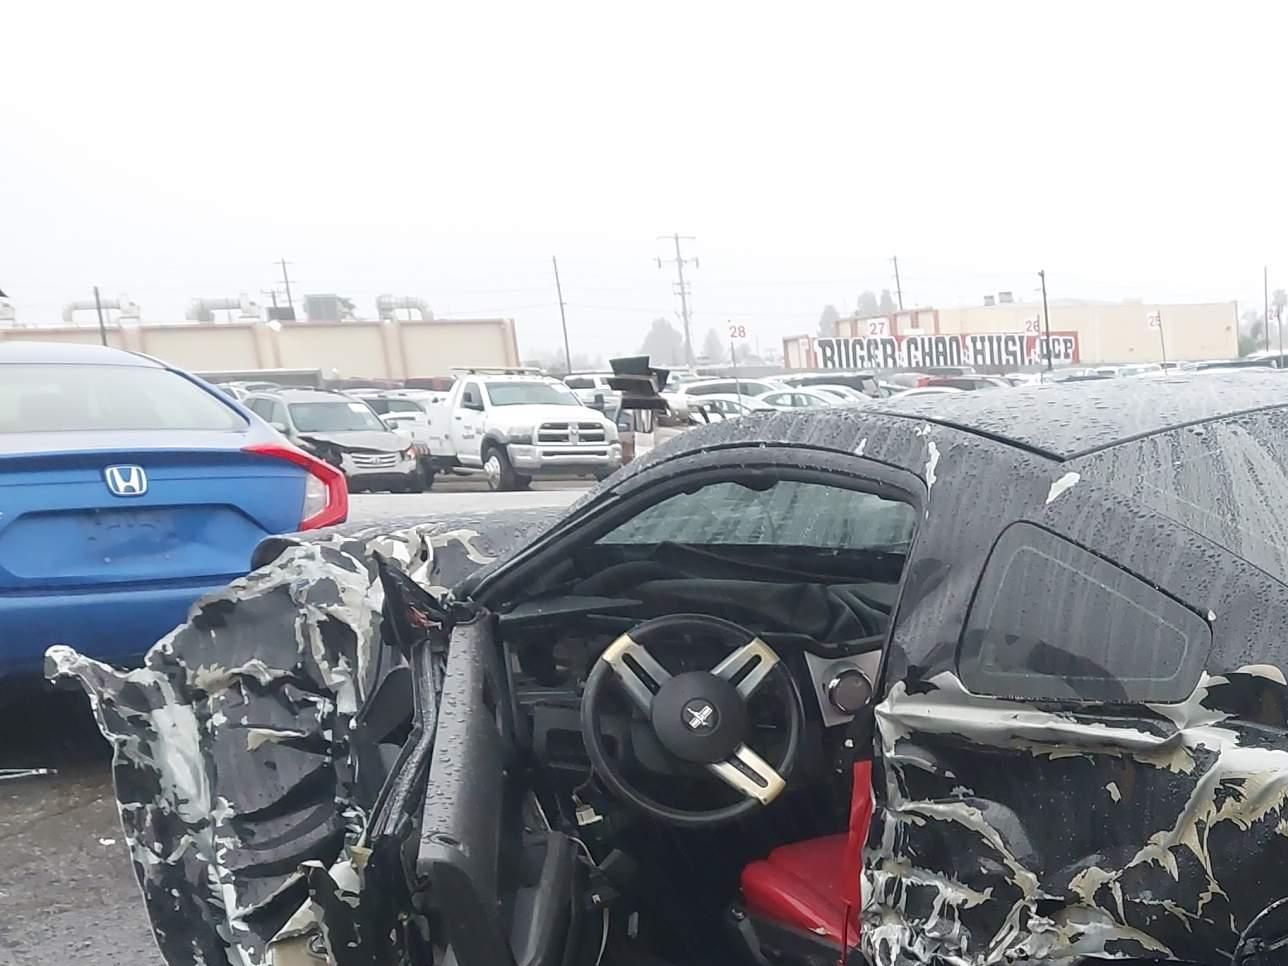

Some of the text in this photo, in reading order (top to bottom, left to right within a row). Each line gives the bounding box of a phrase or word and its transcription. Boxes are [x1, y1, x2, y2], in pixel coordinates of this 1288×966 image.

[729, 326, 746, 339] 28
[869, 322, 885, 336] 27
[1025, 320, 1041, 333] 26
